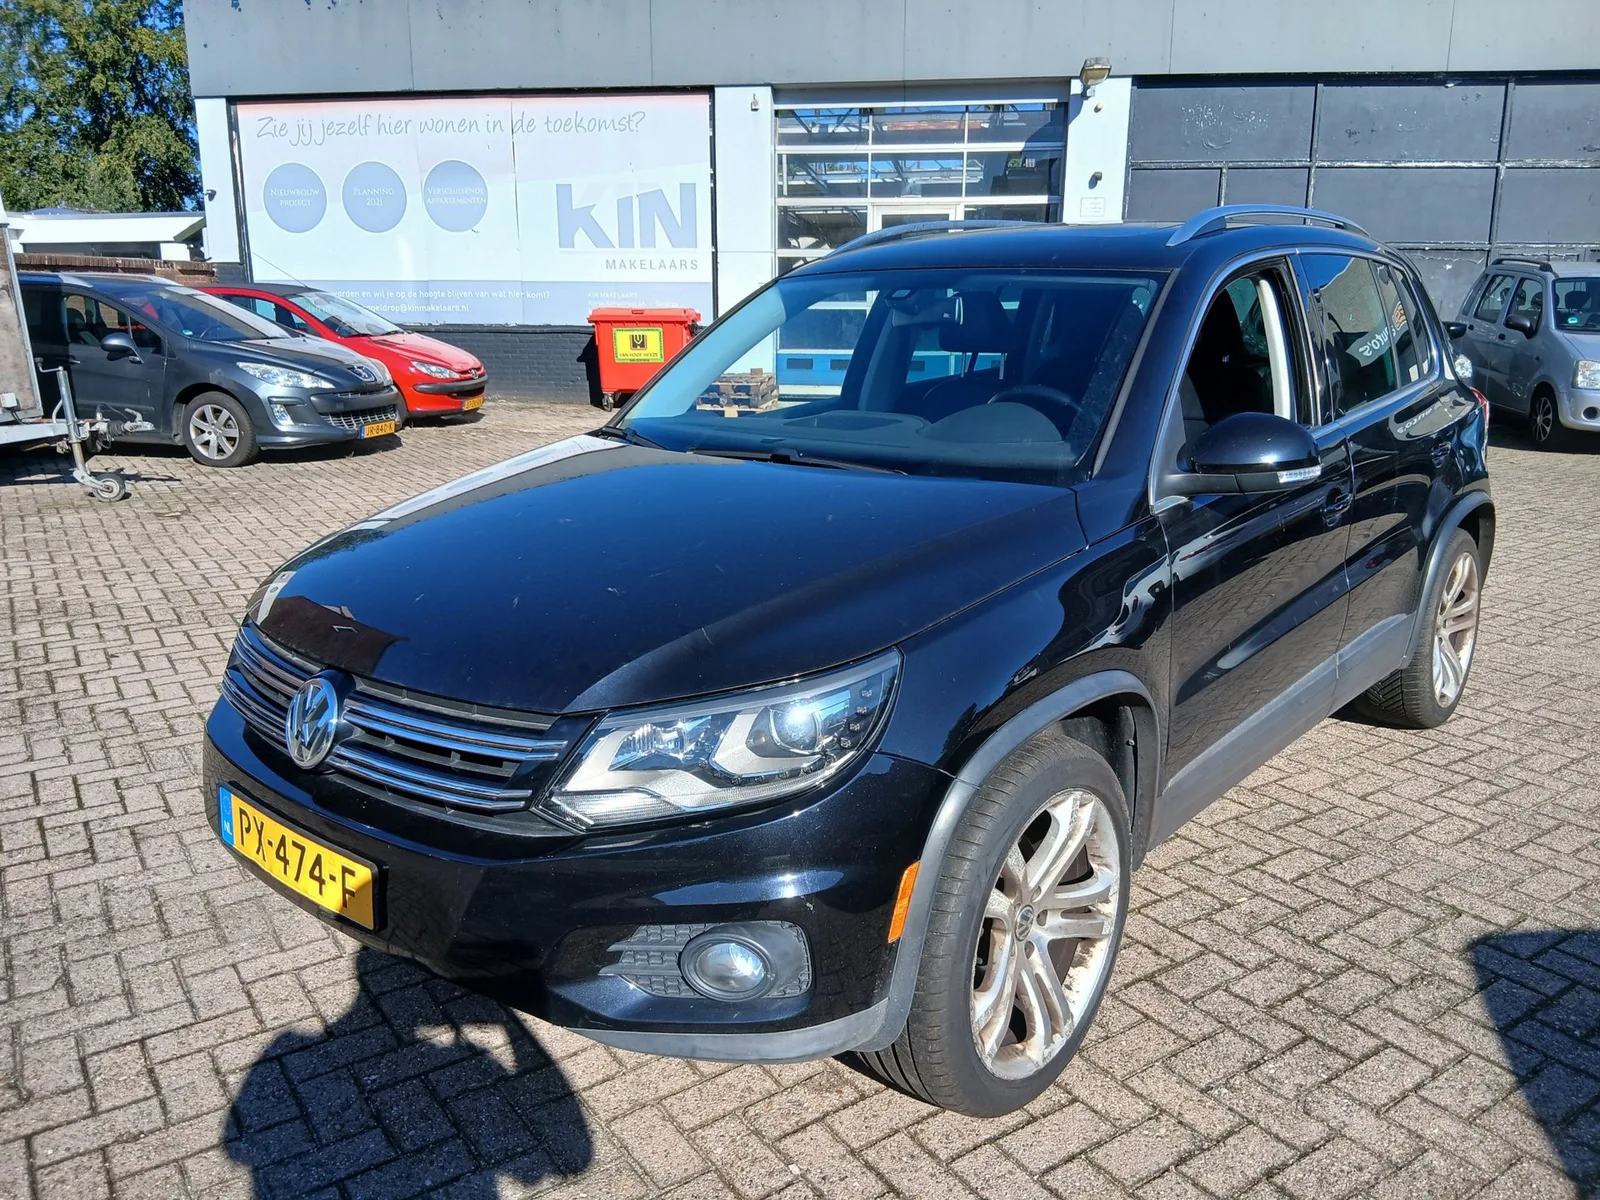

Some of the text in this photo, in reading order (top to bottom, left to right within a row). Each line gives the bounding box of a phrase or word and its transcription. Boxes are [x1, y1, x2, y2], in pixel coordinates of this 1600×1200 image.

[257, 110, 646, 146] Zie jij jezelf hier wonen in de toekomst?
[280, 199, 311, 207] PROJECT
[366, 197, 383, 206] 2021
[556, 182, 698, 249] KIN
[605, 259, 698, 270] MAKELAARS
[374, 290, 385, 298] wil
[386, 290, 393, 299] je
[396, 291, 405, 300] op
[407, 290, 418, 298] de
[420, 290, 445, 299] hoogte
[447, 290, 473, 299] blijven
[491, 290, 506, 298] wat
[508, 290, 524, 298] hier
[526, 290, 550, 299] komt?
[223, 820, 232, 836] NL
[239, 806, 356, 909] PX-474-F
